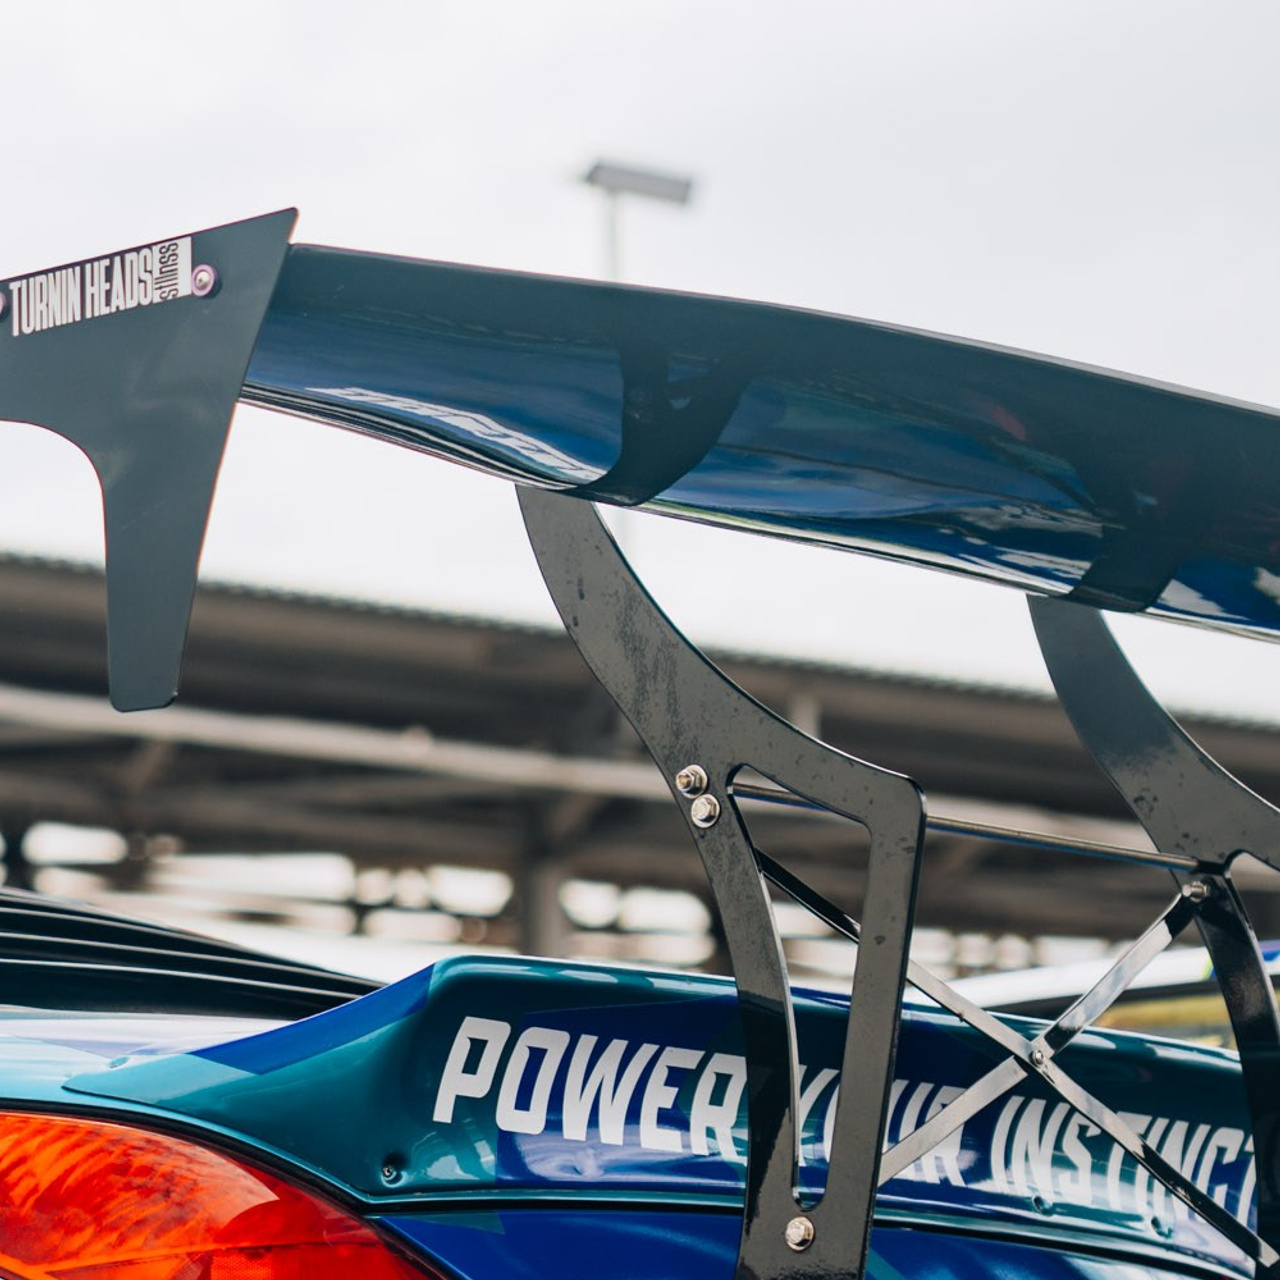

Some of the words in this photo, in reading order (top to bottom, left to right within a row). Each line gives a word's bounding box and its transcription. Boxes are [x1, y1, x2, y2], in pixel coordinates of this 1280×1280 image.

[9, 266, 82, 336] TURNIN
[86, 248, 153, 318] HEADS
[433, 1016, 748, 1166] POWER
